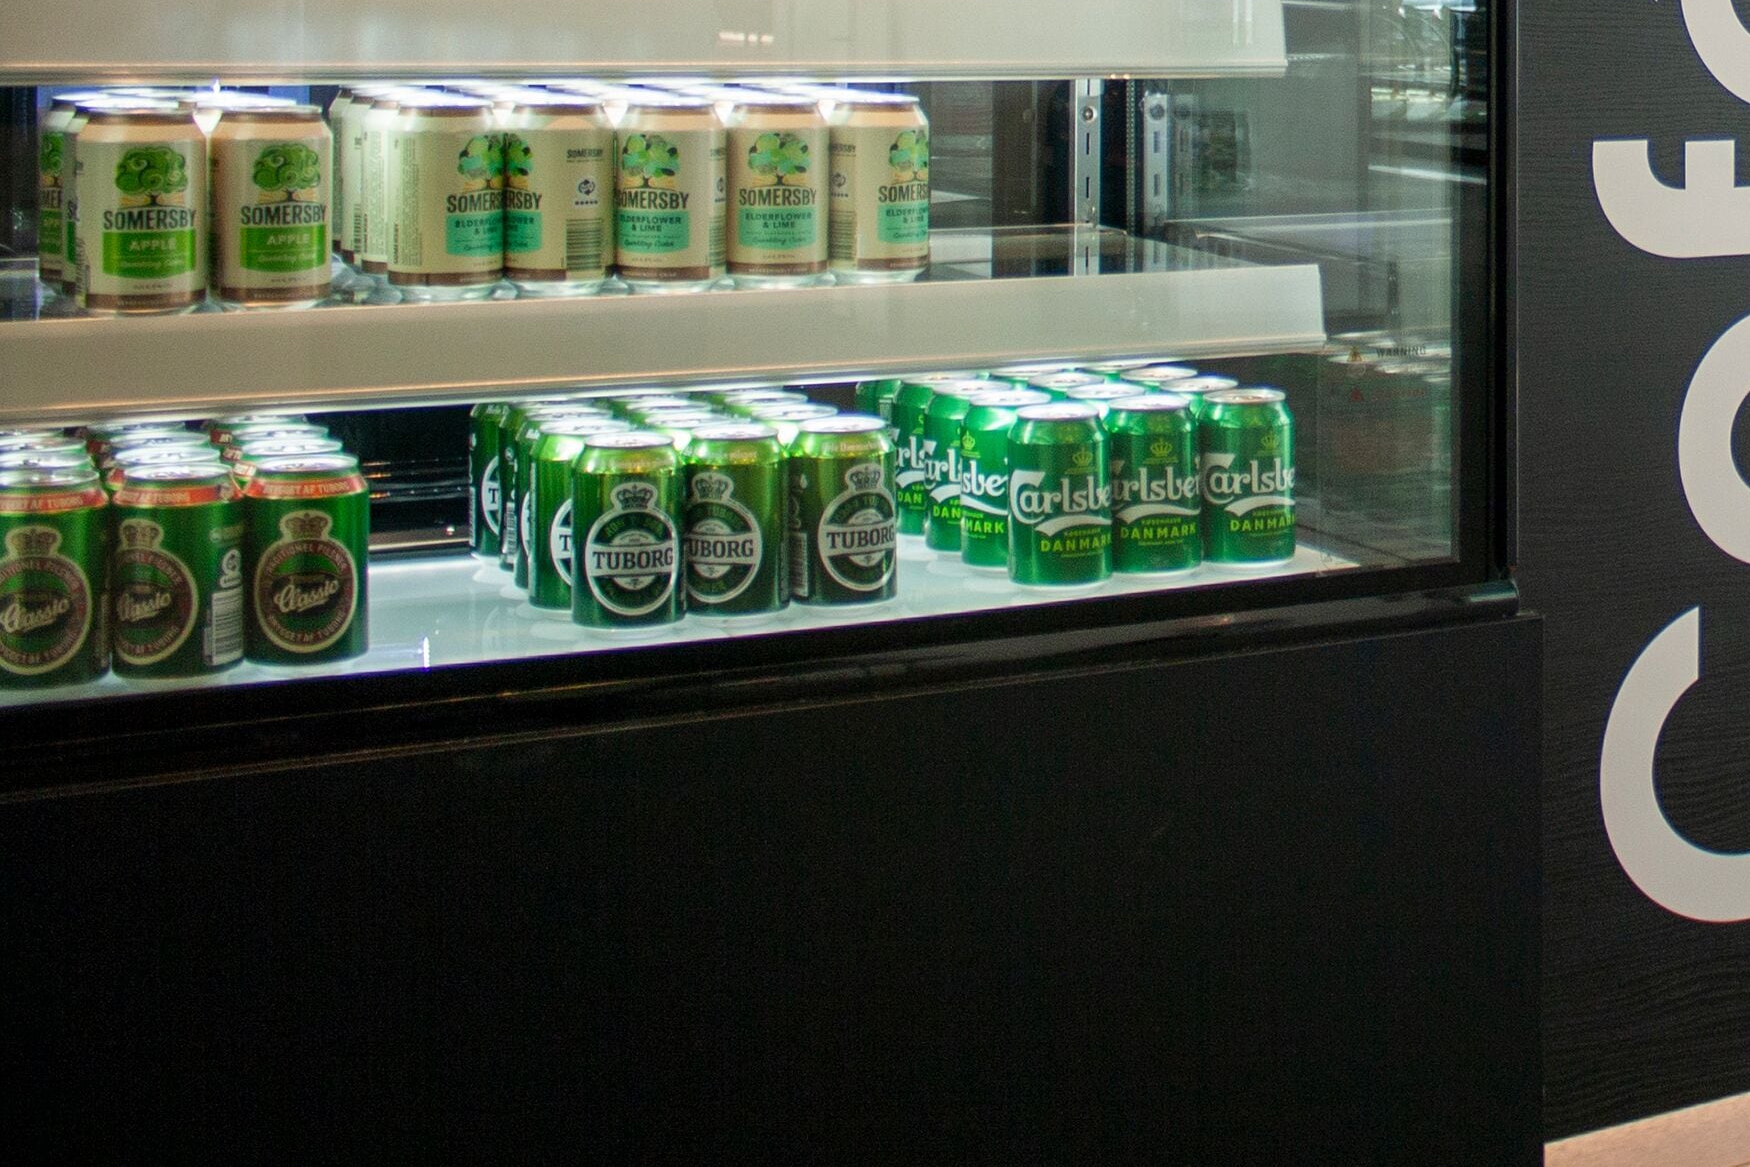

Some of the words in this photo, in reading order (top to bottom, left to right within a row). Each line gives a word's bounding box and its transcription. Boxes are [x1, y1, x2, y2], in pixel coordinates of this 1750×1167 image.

[739, 187, 817, 206] SOMERSBY
[103, 208, 197, 231] SOMERSBY
[240, 203, 327, 226] SOMERSBY
[773, 221, 796, 229] LIME
[826, 523, 894, 549] TUBORG
[1120, 521, 1196, 540] DANMARK
[592, 546, 674, 570] TUBORG
